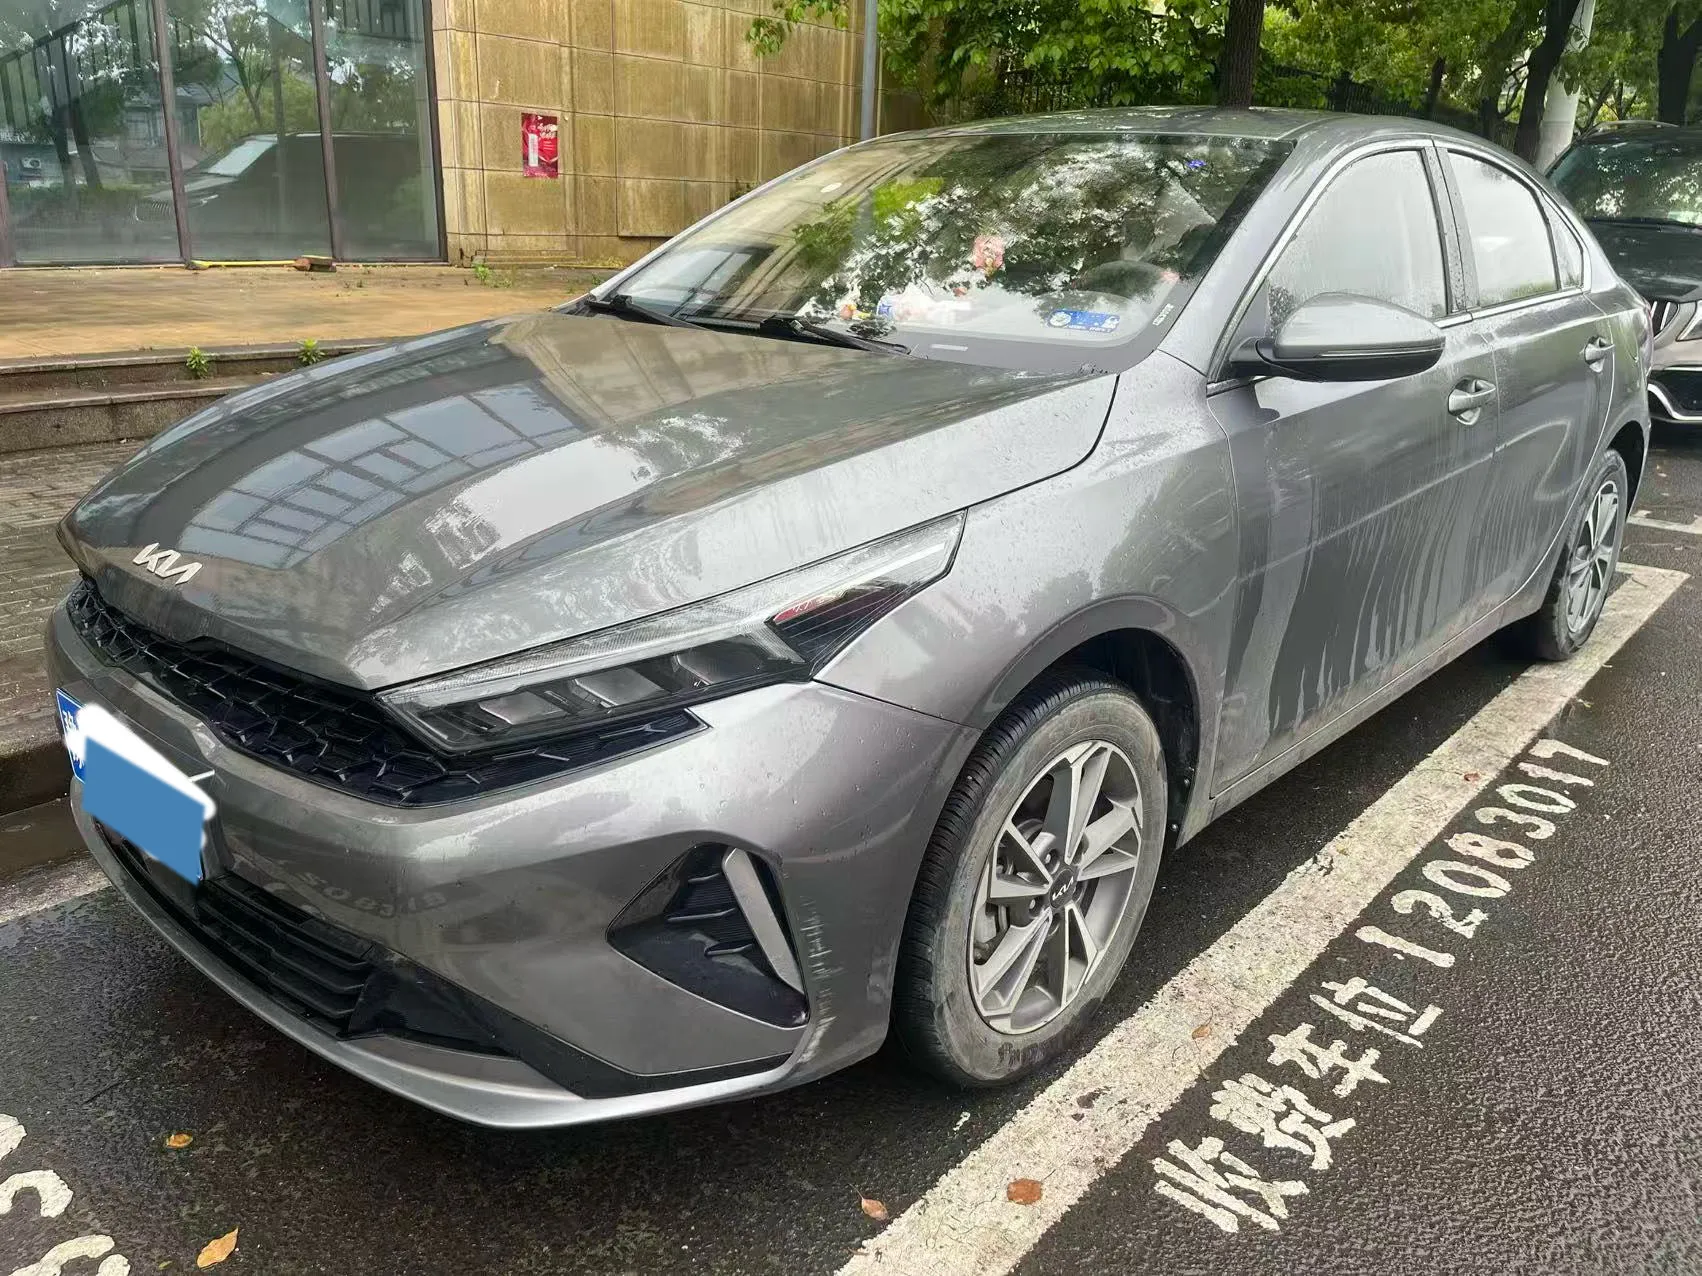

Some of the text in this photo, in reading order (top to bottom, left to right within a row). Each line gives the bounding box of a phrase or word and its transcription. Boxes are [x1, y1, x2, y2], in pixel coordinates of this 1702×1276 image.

[1150, 738, 1611, 1233] 收费车位 12083017
